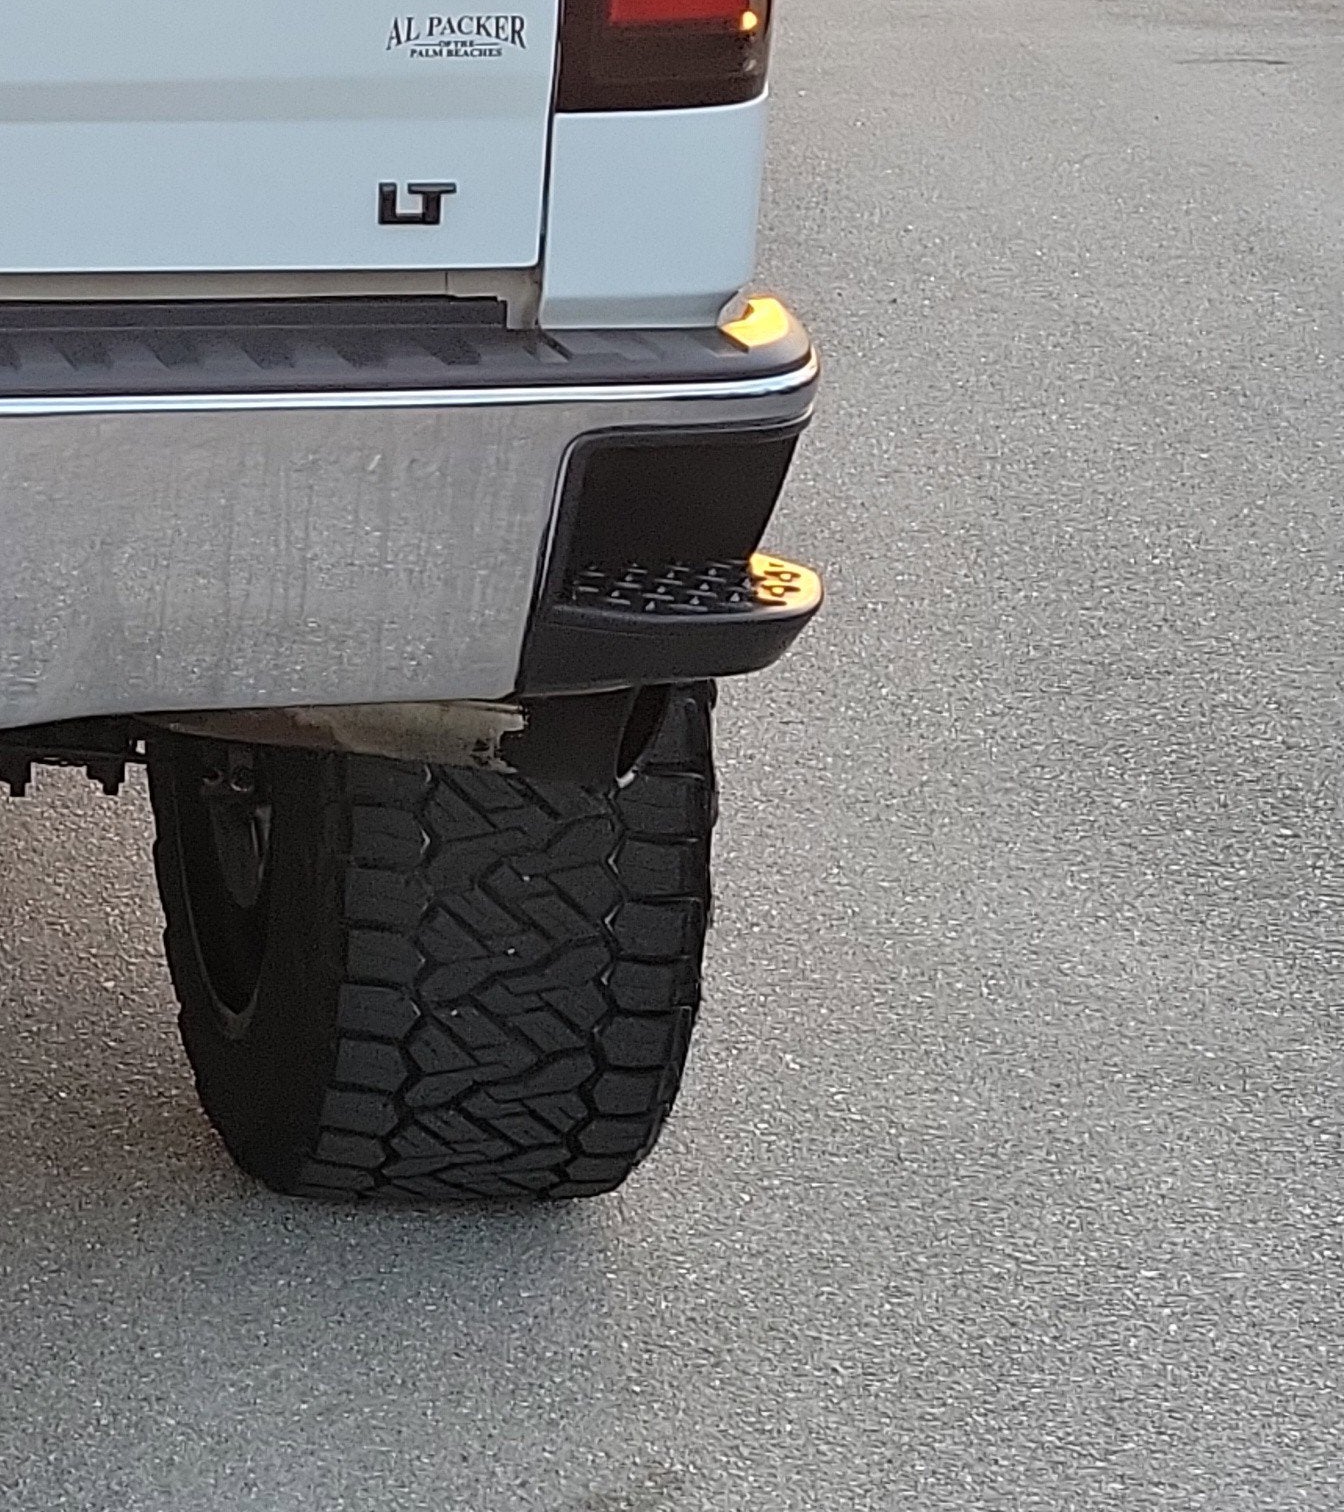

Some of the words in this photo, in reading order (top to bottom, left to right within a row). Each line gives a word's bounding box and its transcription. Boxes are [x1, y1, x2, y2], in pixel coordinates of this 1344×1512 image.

[386, 16, 421, 50] AL
[427, 15, 526, 49] PACKER
[410, 48, 443, 58] PALM
[446, 48, 502, 57] BEACHES
[378, 182, 457, 225] LT
